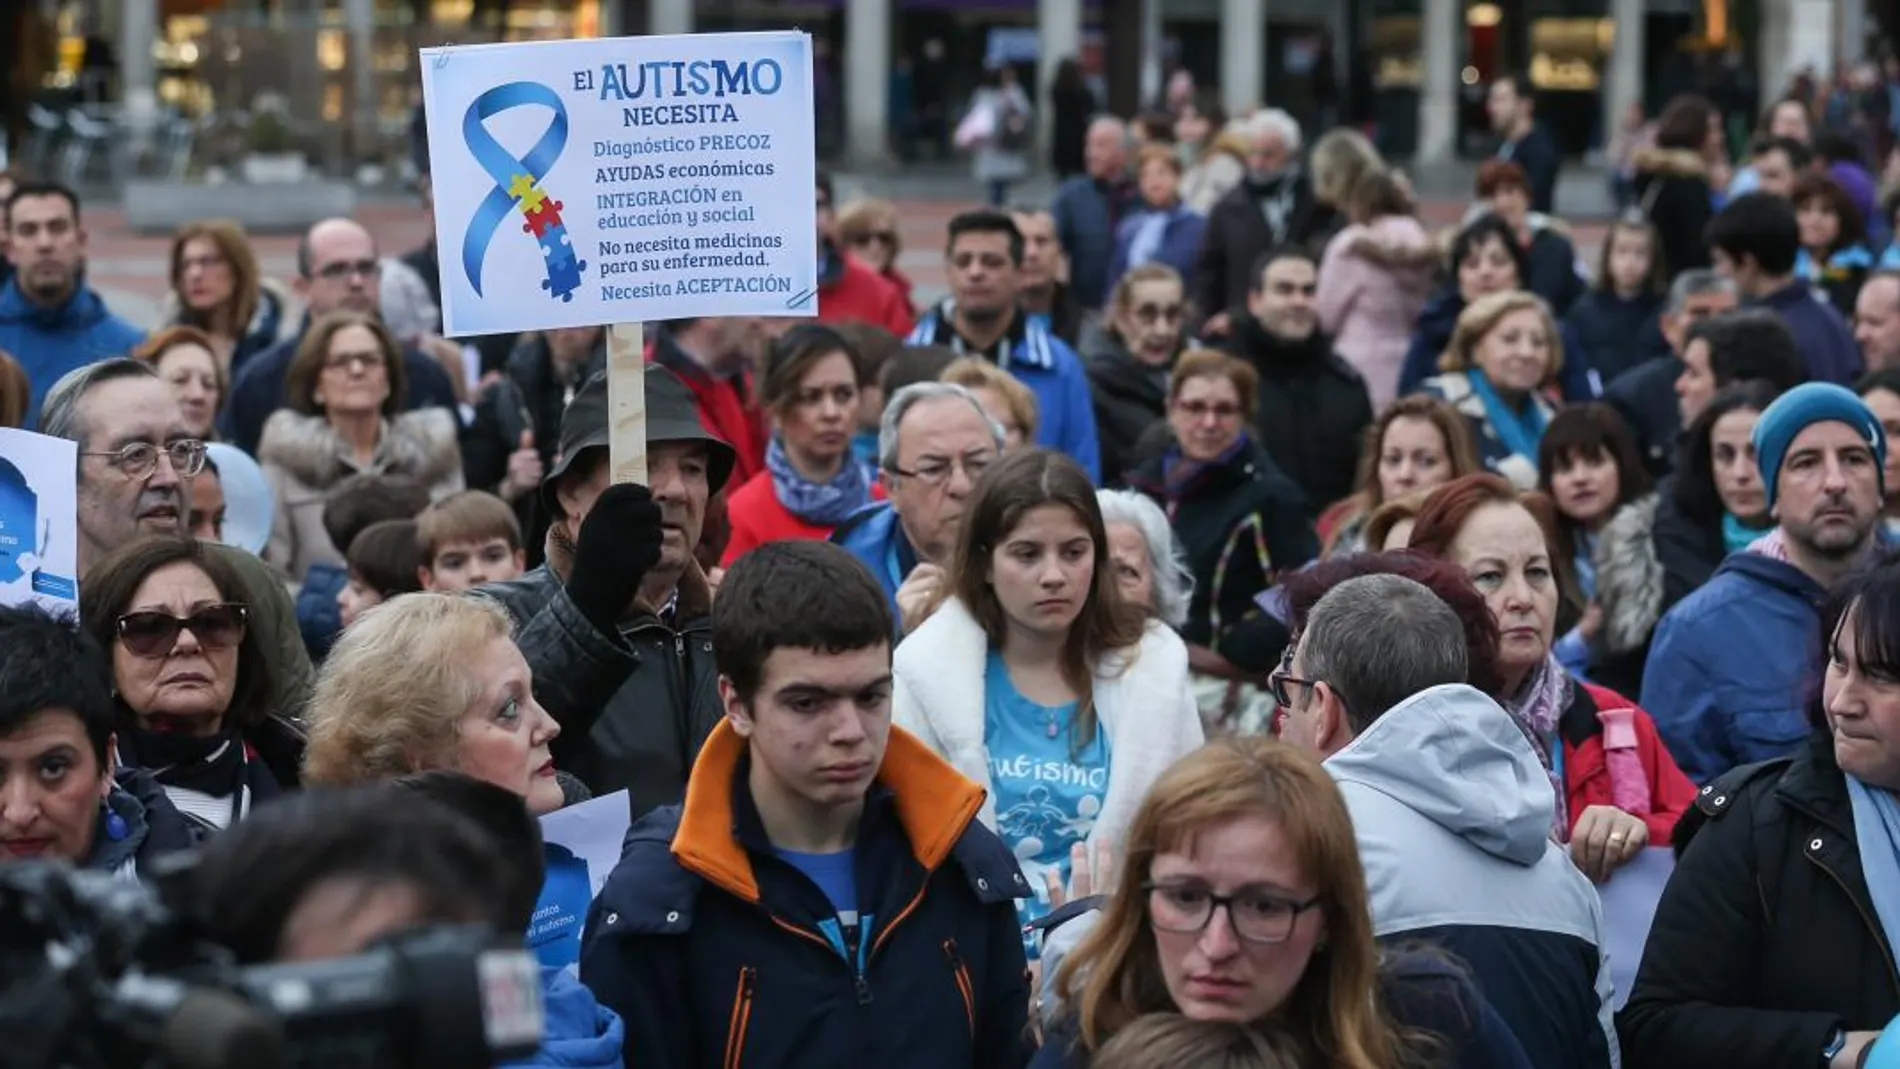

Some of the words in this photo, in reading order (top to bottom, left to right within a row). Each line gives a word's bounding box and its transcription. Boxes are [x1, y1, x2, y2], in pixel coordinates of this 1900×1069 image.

[573, 70, 593, 91] El
[601, 58, 782, 100] AUTISMO
[623, 103, 739, 127] NECESITA
[594, 137, 695, 159] Diagnóstico
[700, 134, 771, 151] PRECOZ
[595, 164, 664, 183] AYUDAS
[668, 160, 774, 179] económicas
[597, 185, 716, 209] INTEGRACIÓN
[721, 189, 742, 202] en
[598, 209, 682, 229] educación
[687, 211, 698, 227] y
[702, 206, 755, 222] social
[599, 241, 621, 256] No
[624, 235, 690, 254] necesita
[695, 233, 782, 249] medicinas
[600, 260, 638, 278] para
[641, 257, 660, 271] su
[663, 251, 770, 270] enfermedad.
[602, 282, 671, 301] Necesita
[676, 273, 791, 295] ACEPTACIÓN
